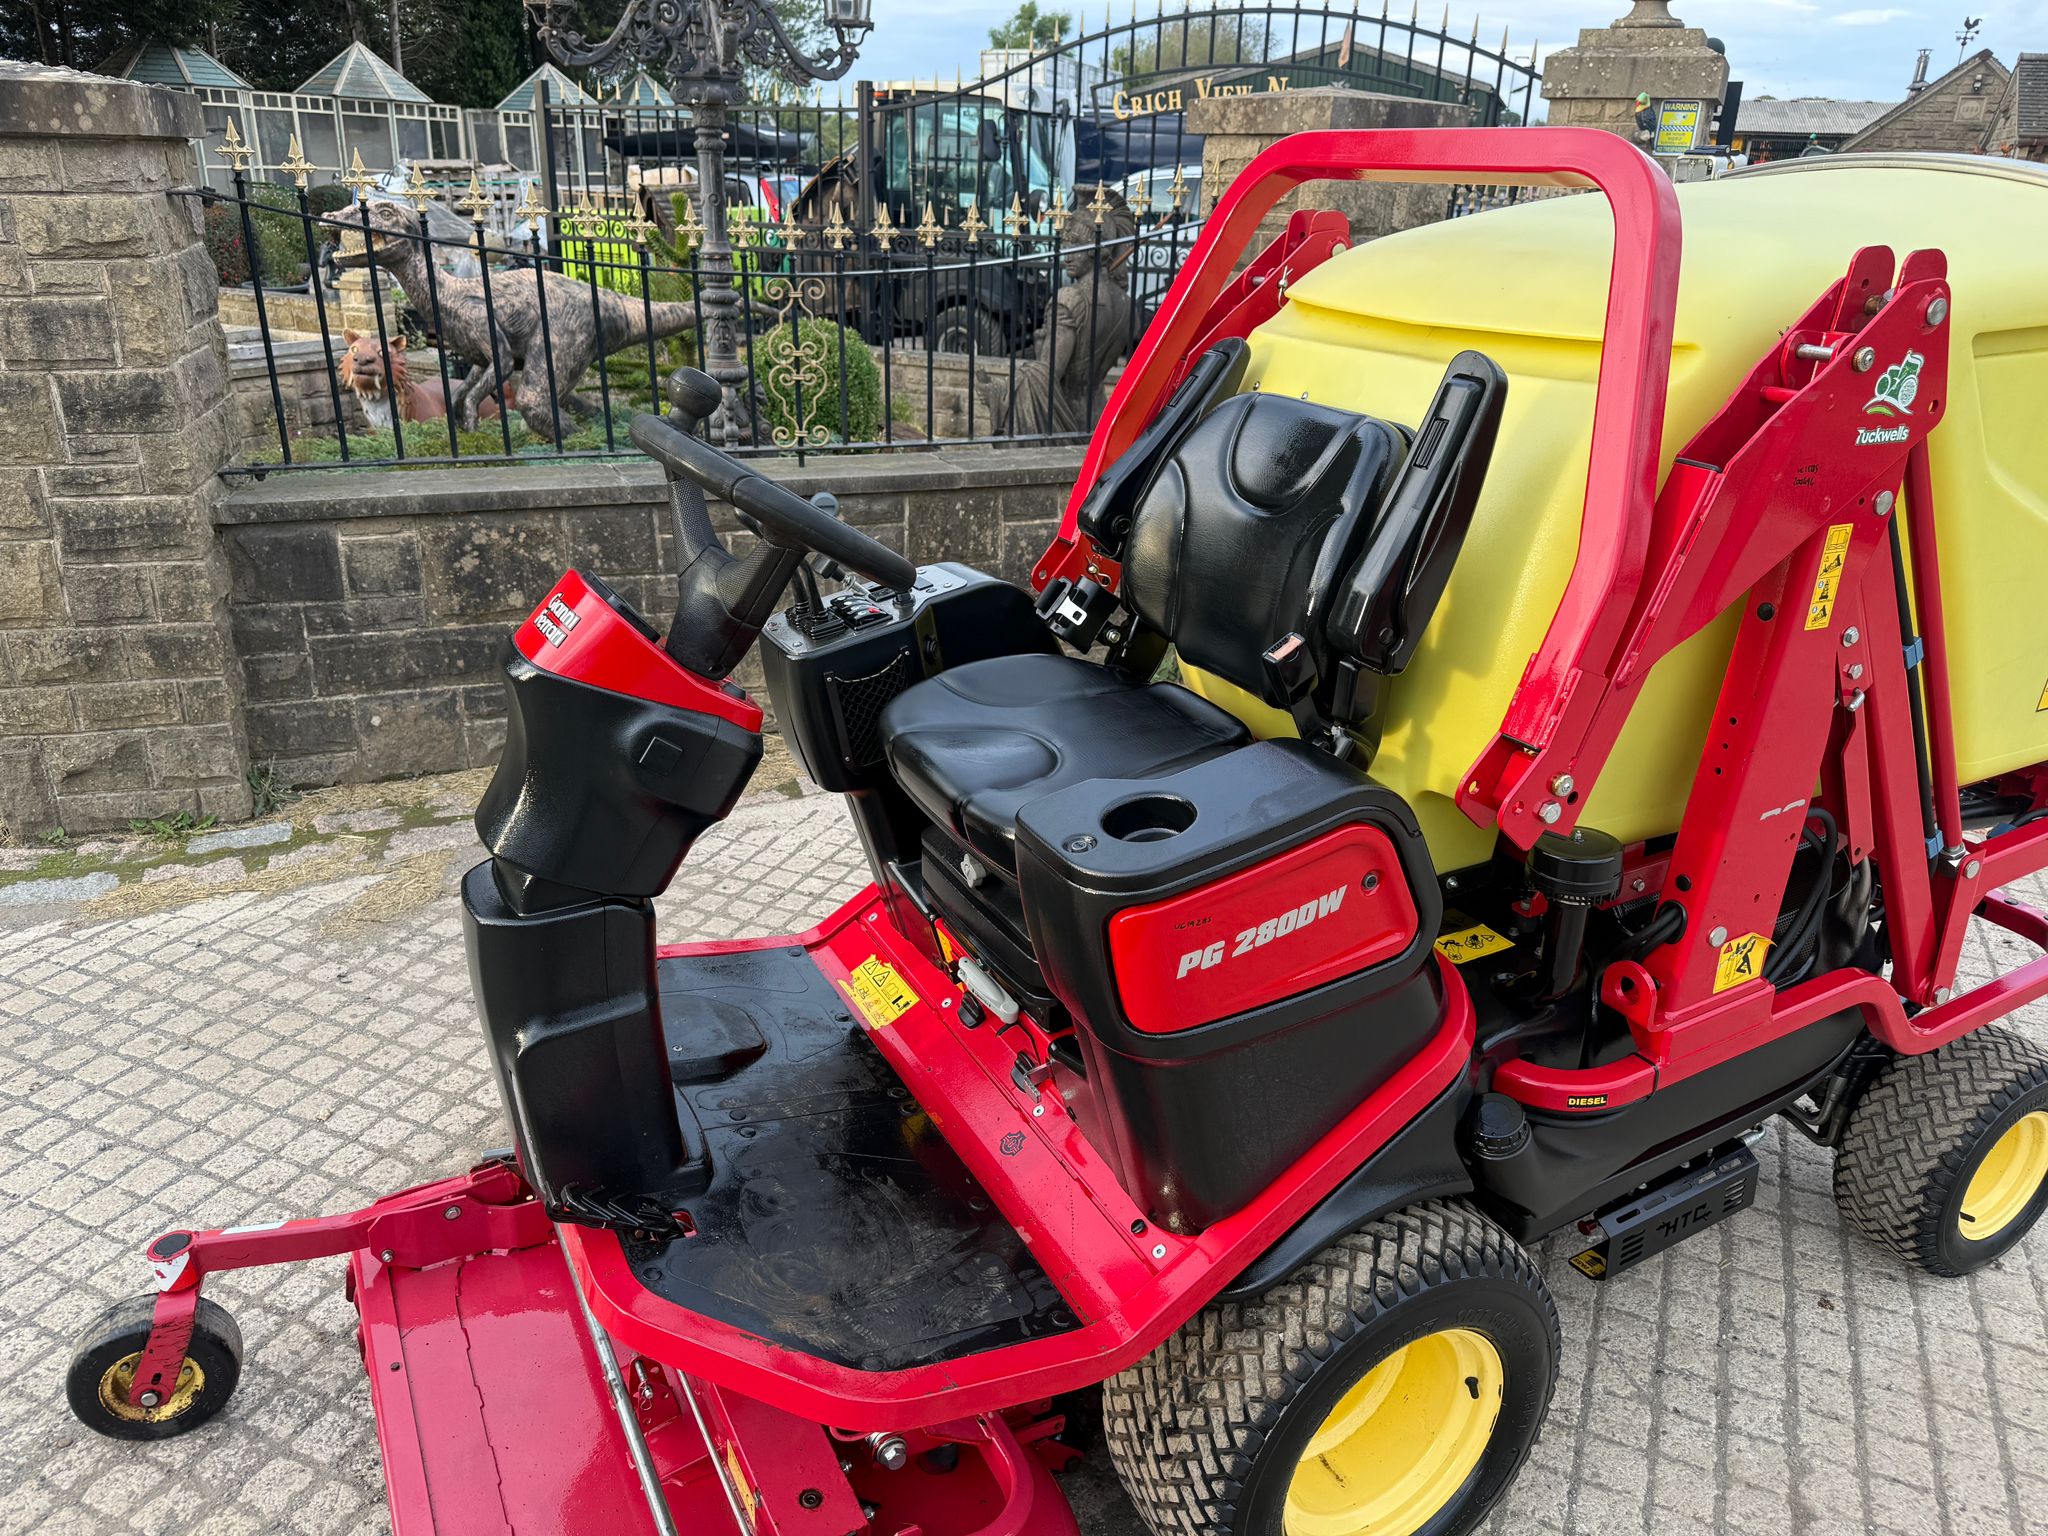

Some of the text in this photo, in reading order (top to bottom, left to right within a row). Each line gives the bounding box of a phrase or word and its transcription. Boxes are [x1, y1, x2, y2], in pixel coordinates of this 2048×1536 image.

[1113, 75, 1295, 120] CRICH VIEW N
[1664, 102, 1698, 111] WARNING
[1855, 424, 1909, 445] Tuckwells
[1176, 940, 1225, 980] PG
[1568, 1096, 1607, 1107] DIESEL
[1656, 1203, 1712, 1237] HTC
